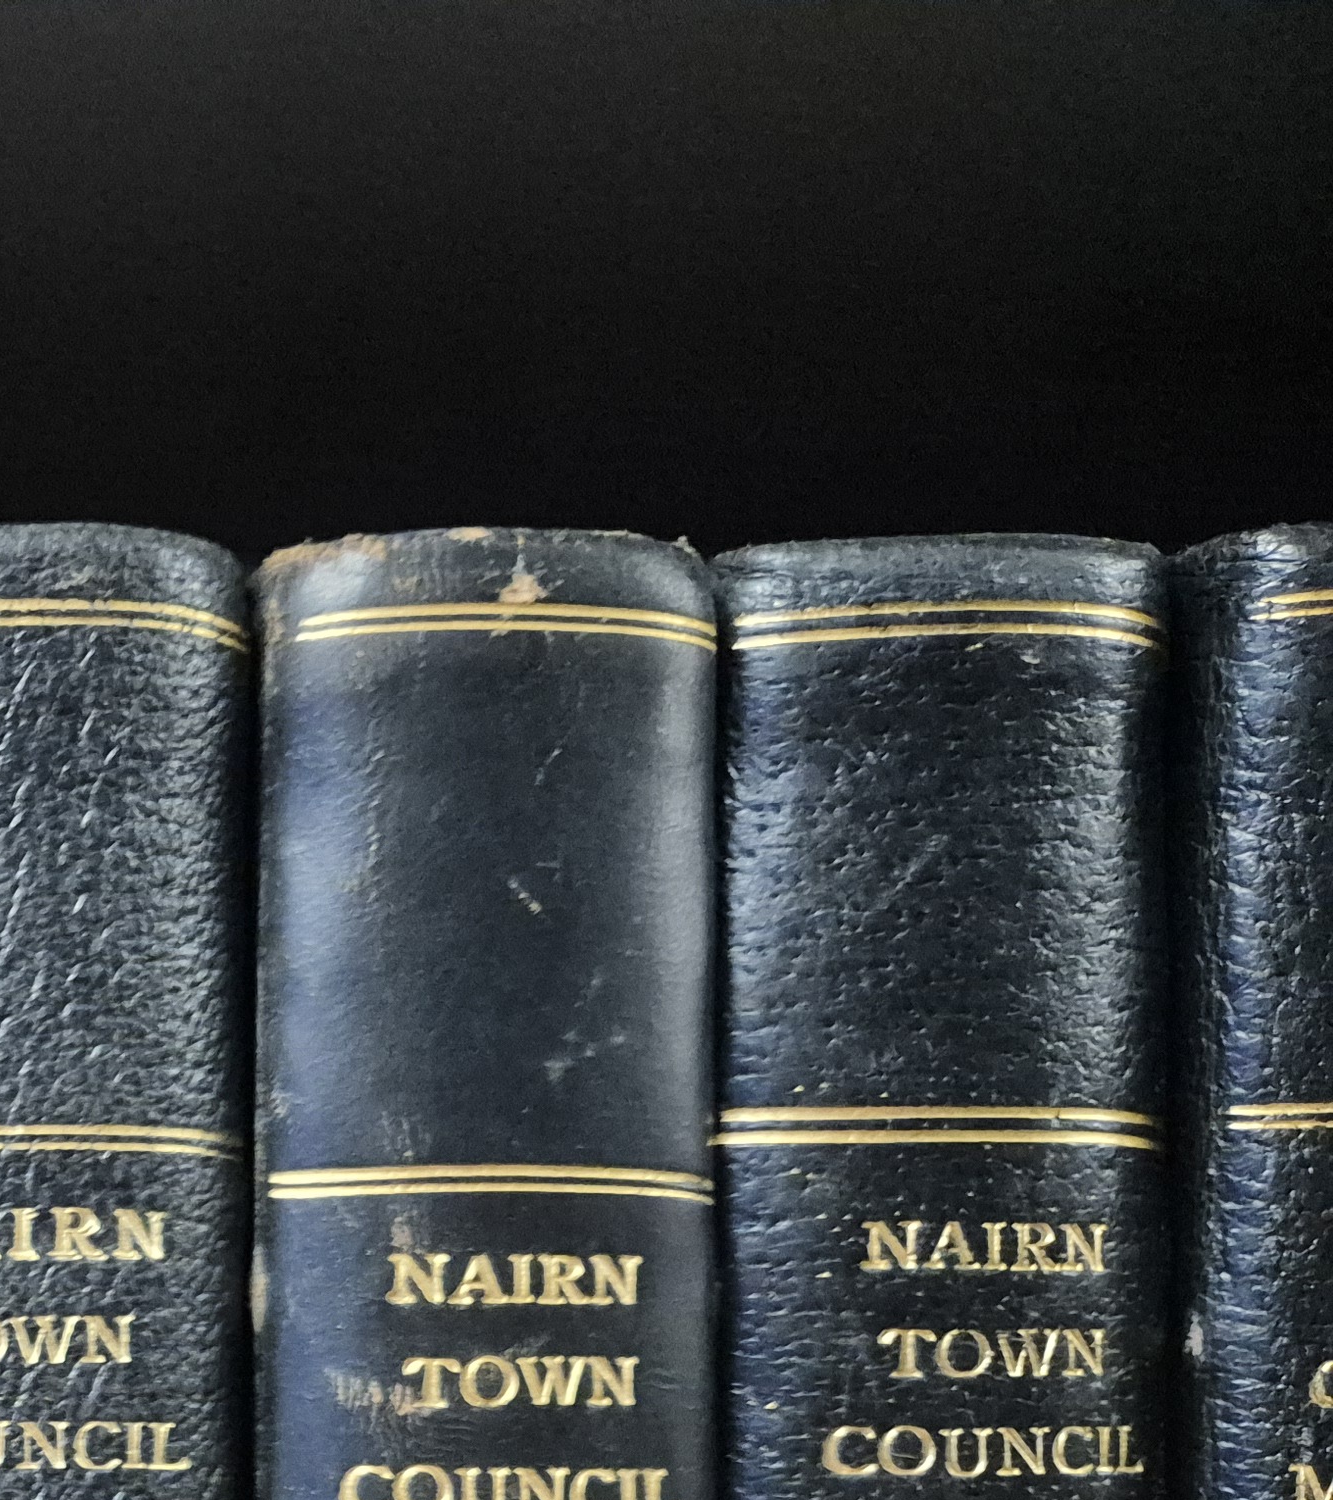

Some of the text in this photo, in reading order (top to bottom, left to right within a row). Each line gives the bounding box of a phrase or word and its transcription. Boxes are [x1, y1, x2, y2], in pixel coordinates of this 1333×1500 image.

[860, 1221, 1109, 1272] NAIRN
[386, 1253, 643, 1305] NAIRN
[877, 1328, 1105, 1379] TOWN
[402, 1355, 639, 1409] TOWN
[821, 1426, 1144, 1478] COUNCIL
